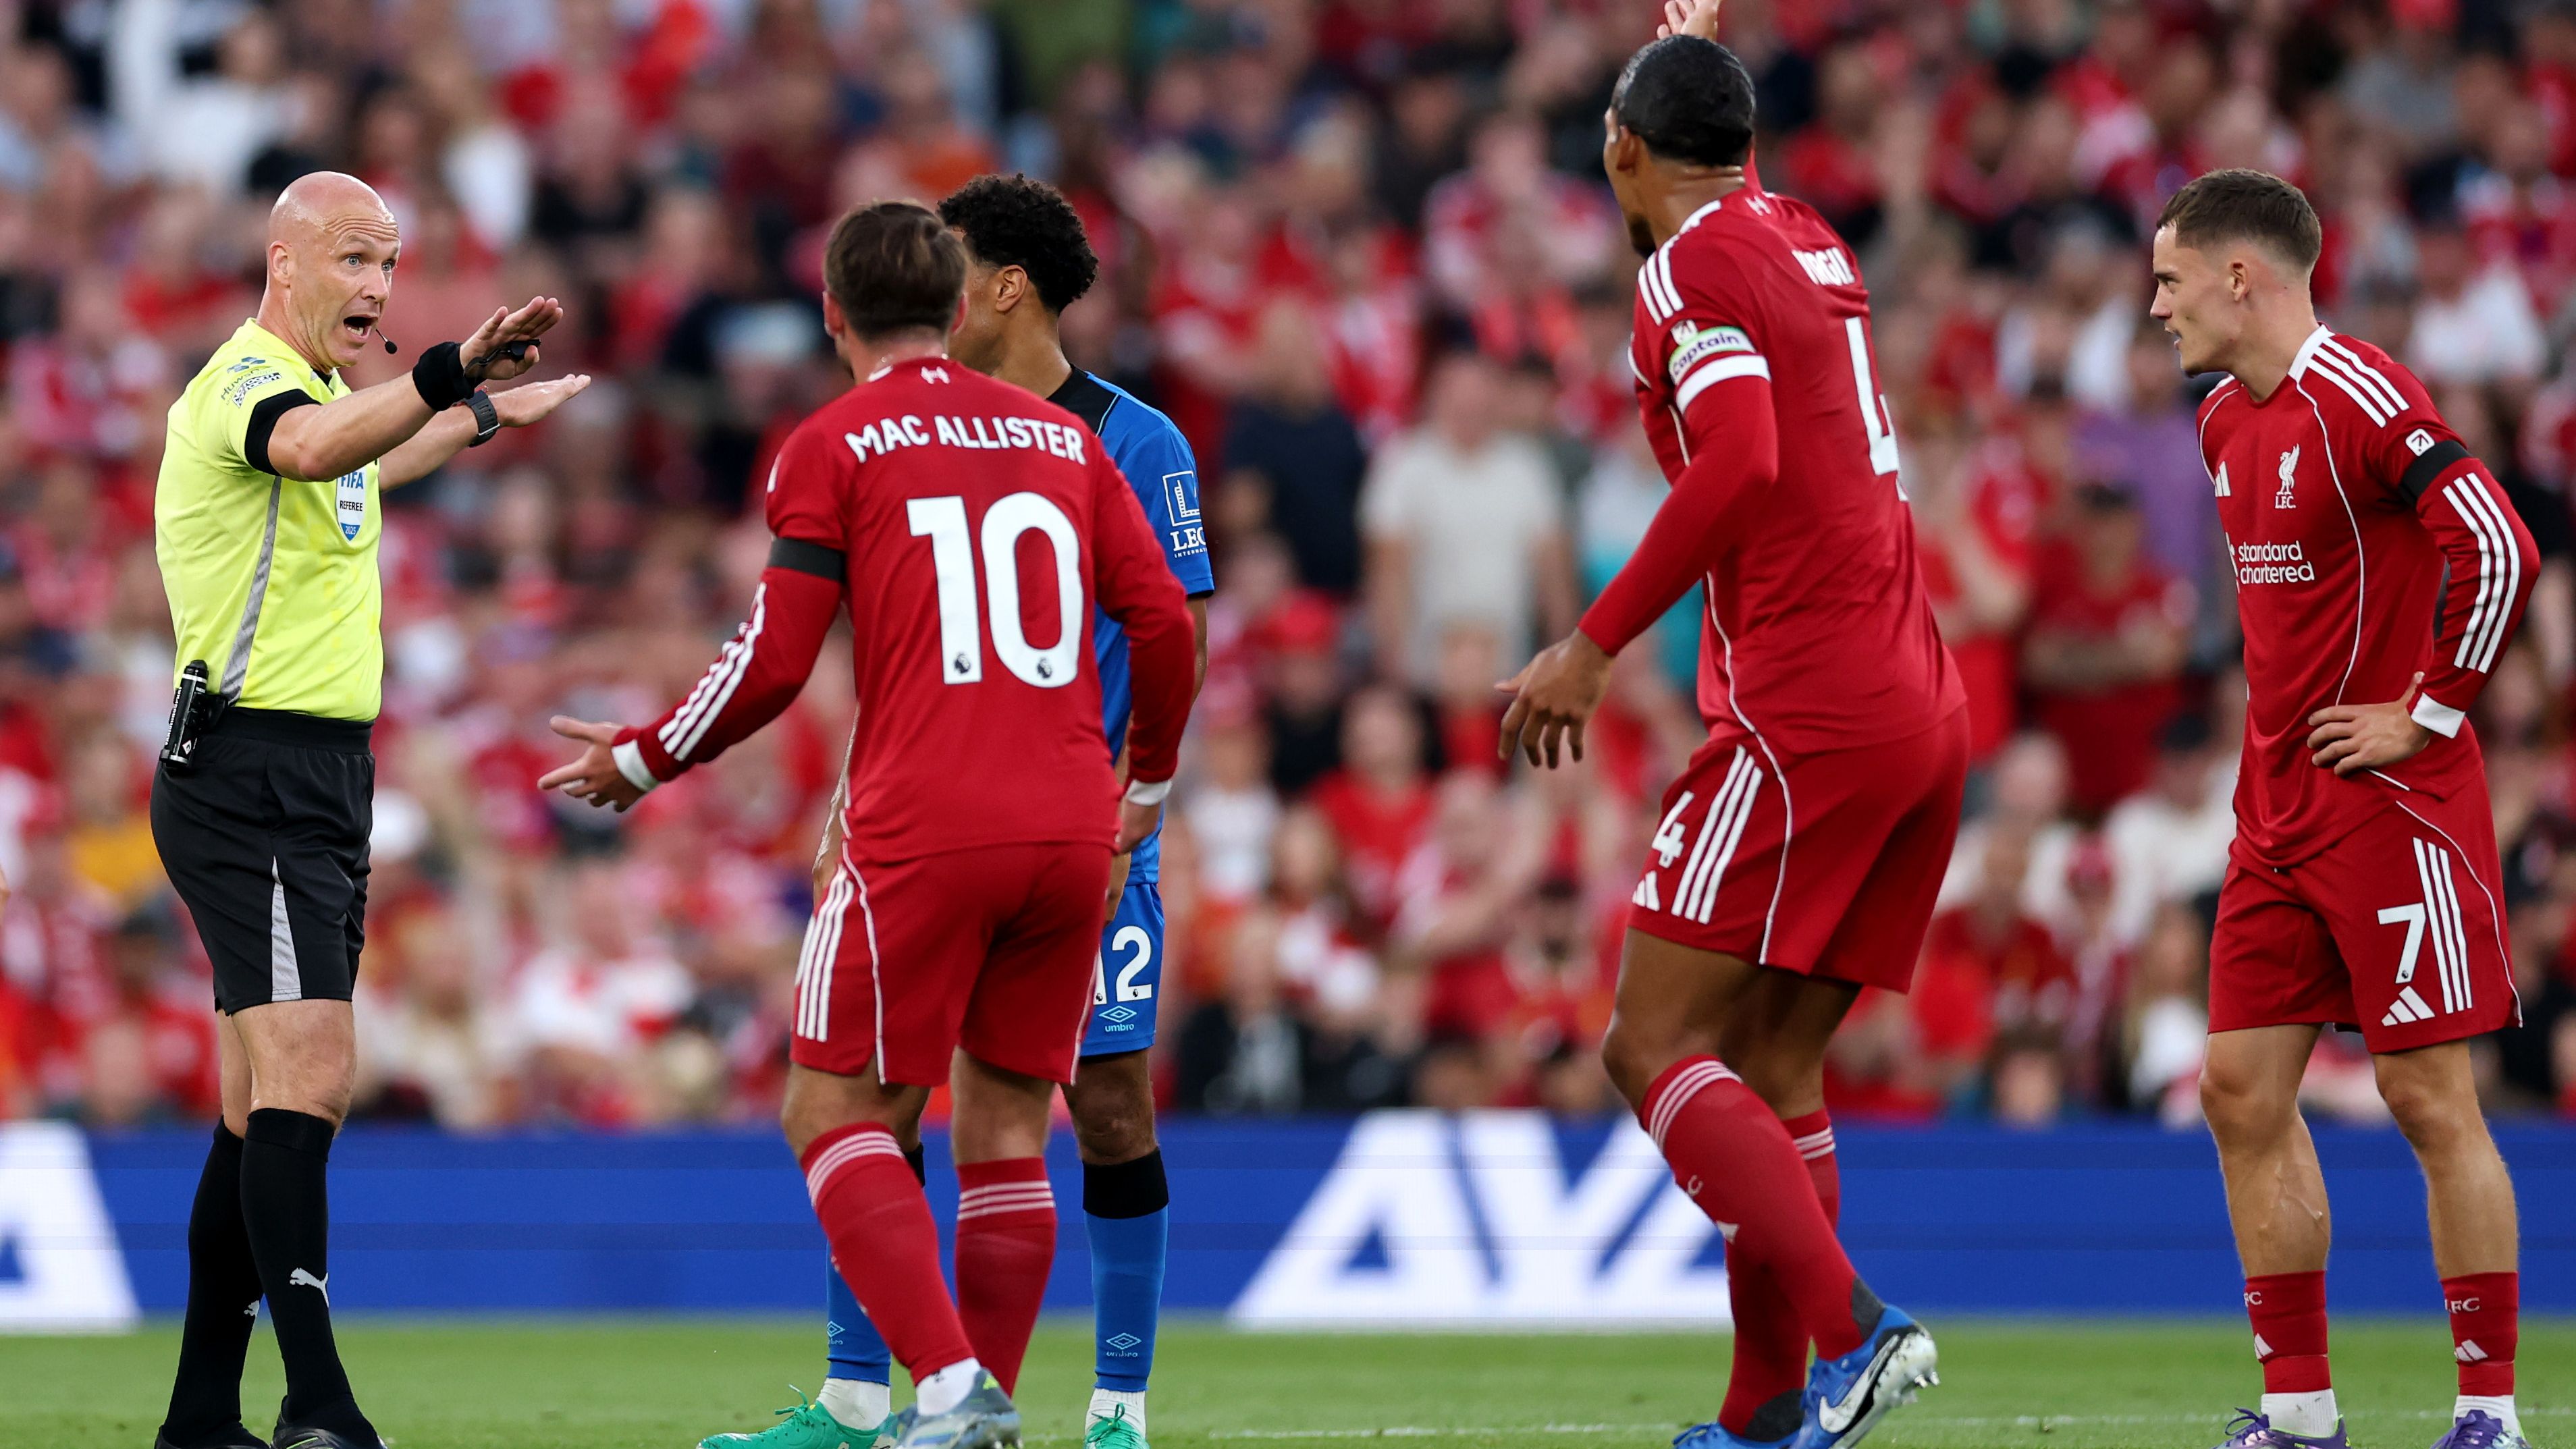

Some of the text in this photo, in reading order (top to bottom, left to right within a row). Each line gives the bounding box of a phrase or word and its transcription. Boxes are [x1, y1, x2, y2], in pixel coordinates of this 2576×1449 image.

[844, 414, 1087, 465] MAC ALLISTER
[341, 472, 364, 489] FIFA
[340, 500, 363, 512] REFEREE
[345, 526, 356, 535] 2025
[2238, 540, 2303, 562] standard
[2240, 561, 2315, 584] chartered
[906, 491, 1084, 688] 10
[1651, 790, 1695, 868] 4
[2377, 902, 2426, 984] 7
[1105, 1023, 1135, 1033] umbro
